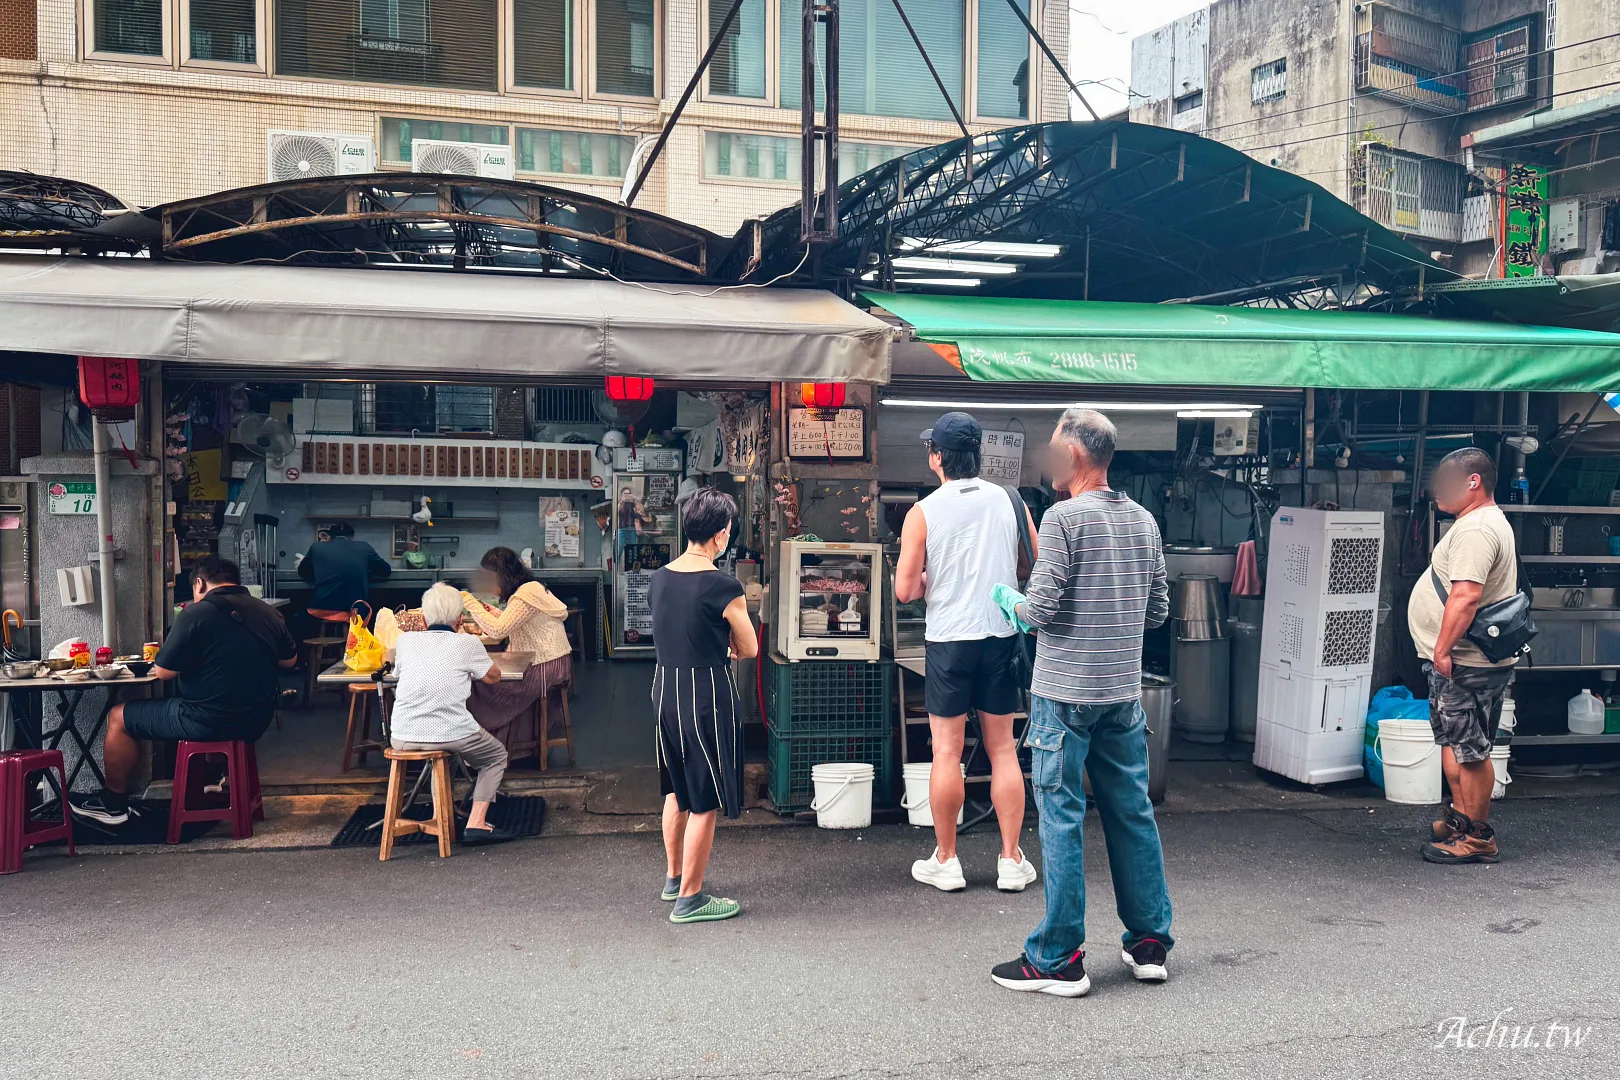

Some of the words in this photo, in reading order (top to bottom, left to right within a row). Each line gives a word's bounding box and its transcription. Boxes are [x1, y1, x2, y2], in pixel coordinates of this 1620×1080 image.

[962, 348, 1031, 366] 洗帆布
[1050, 351, 1138, 371] 2888-1515
[73, 499, 92, 513] 10
